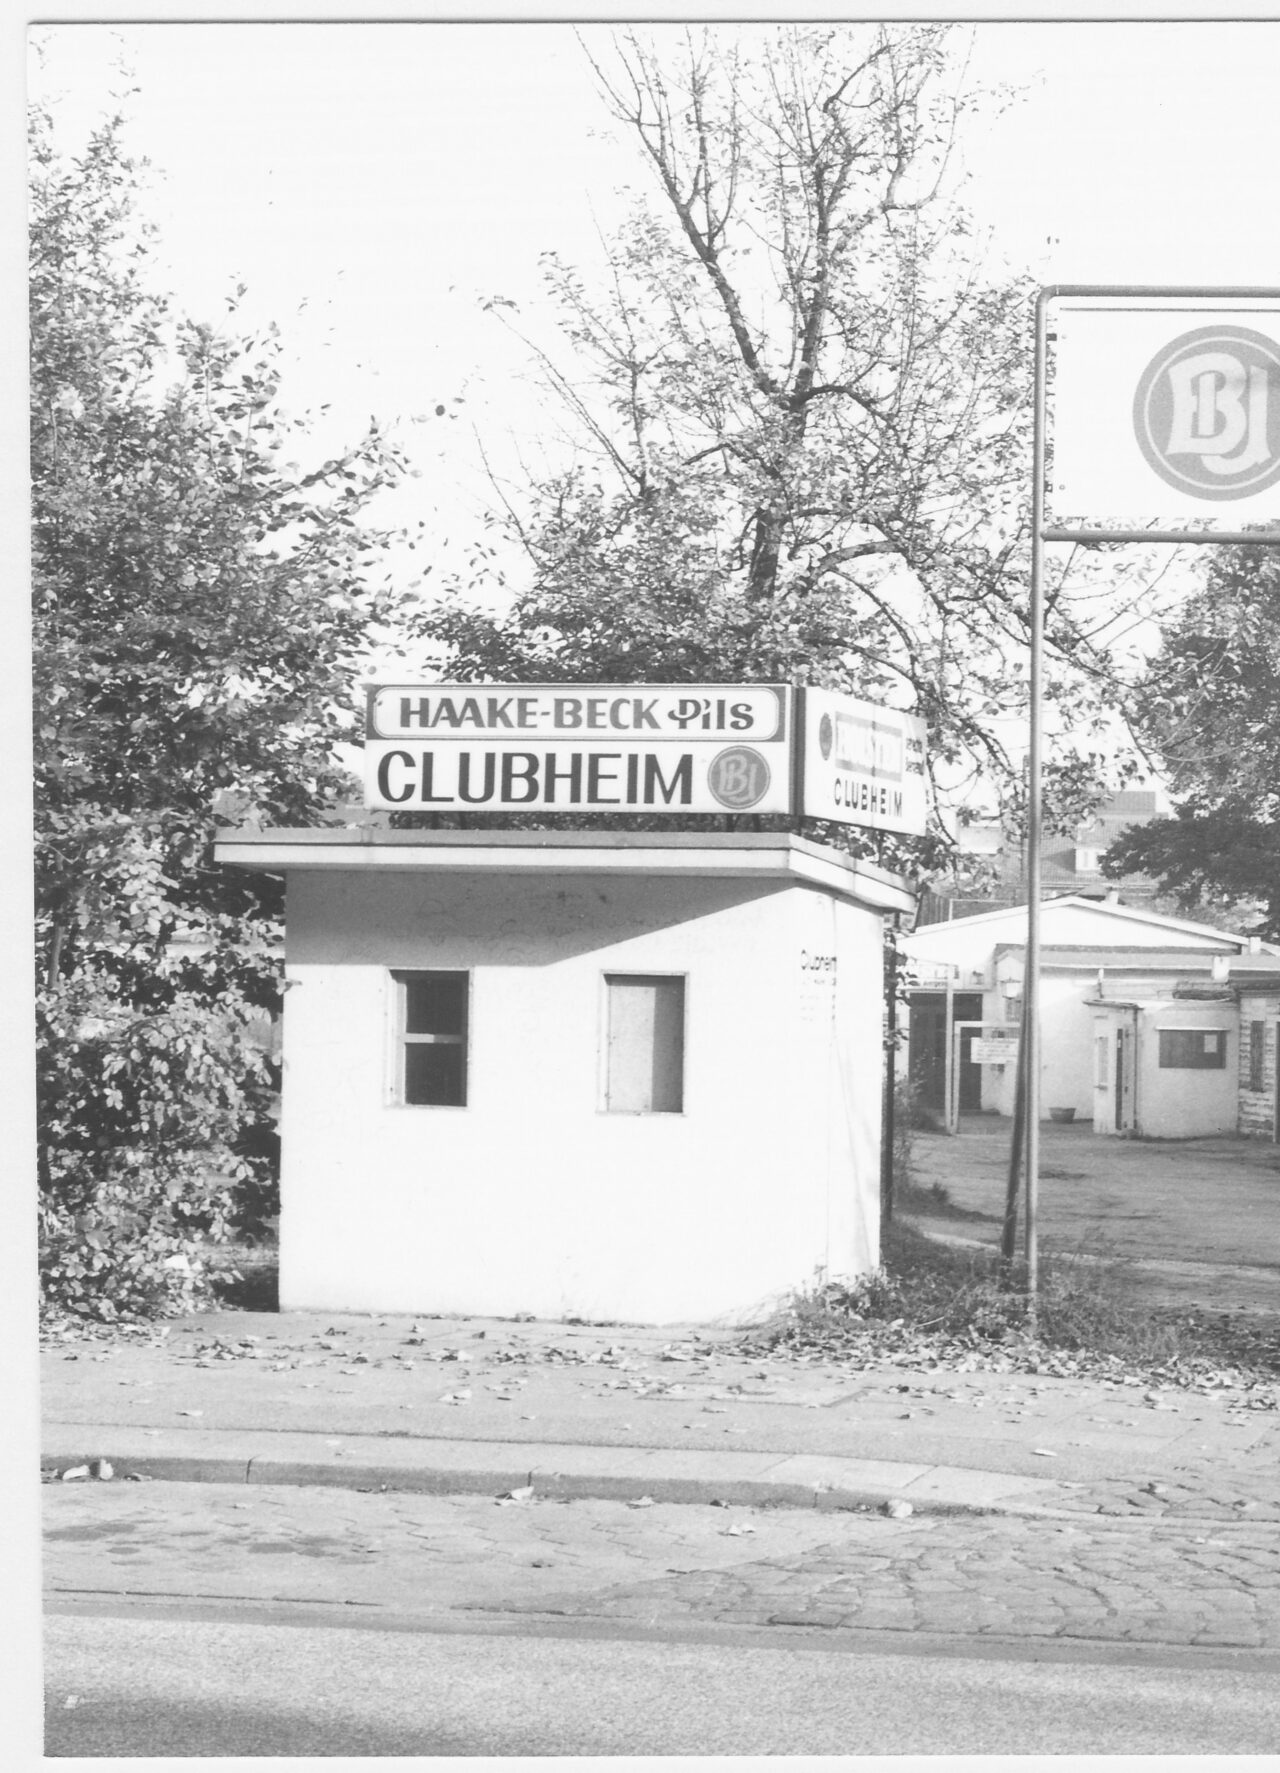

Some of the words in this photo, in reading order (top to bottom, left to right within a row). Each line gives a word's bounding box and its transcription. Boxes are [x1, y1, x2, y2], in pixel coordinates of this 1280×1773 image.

[398, 698, 662, 730] HAAKE-BECK
[376, 749, 694, 805] CLUBHEIM
[833, 777, 903, 818] CLUBHEIM
